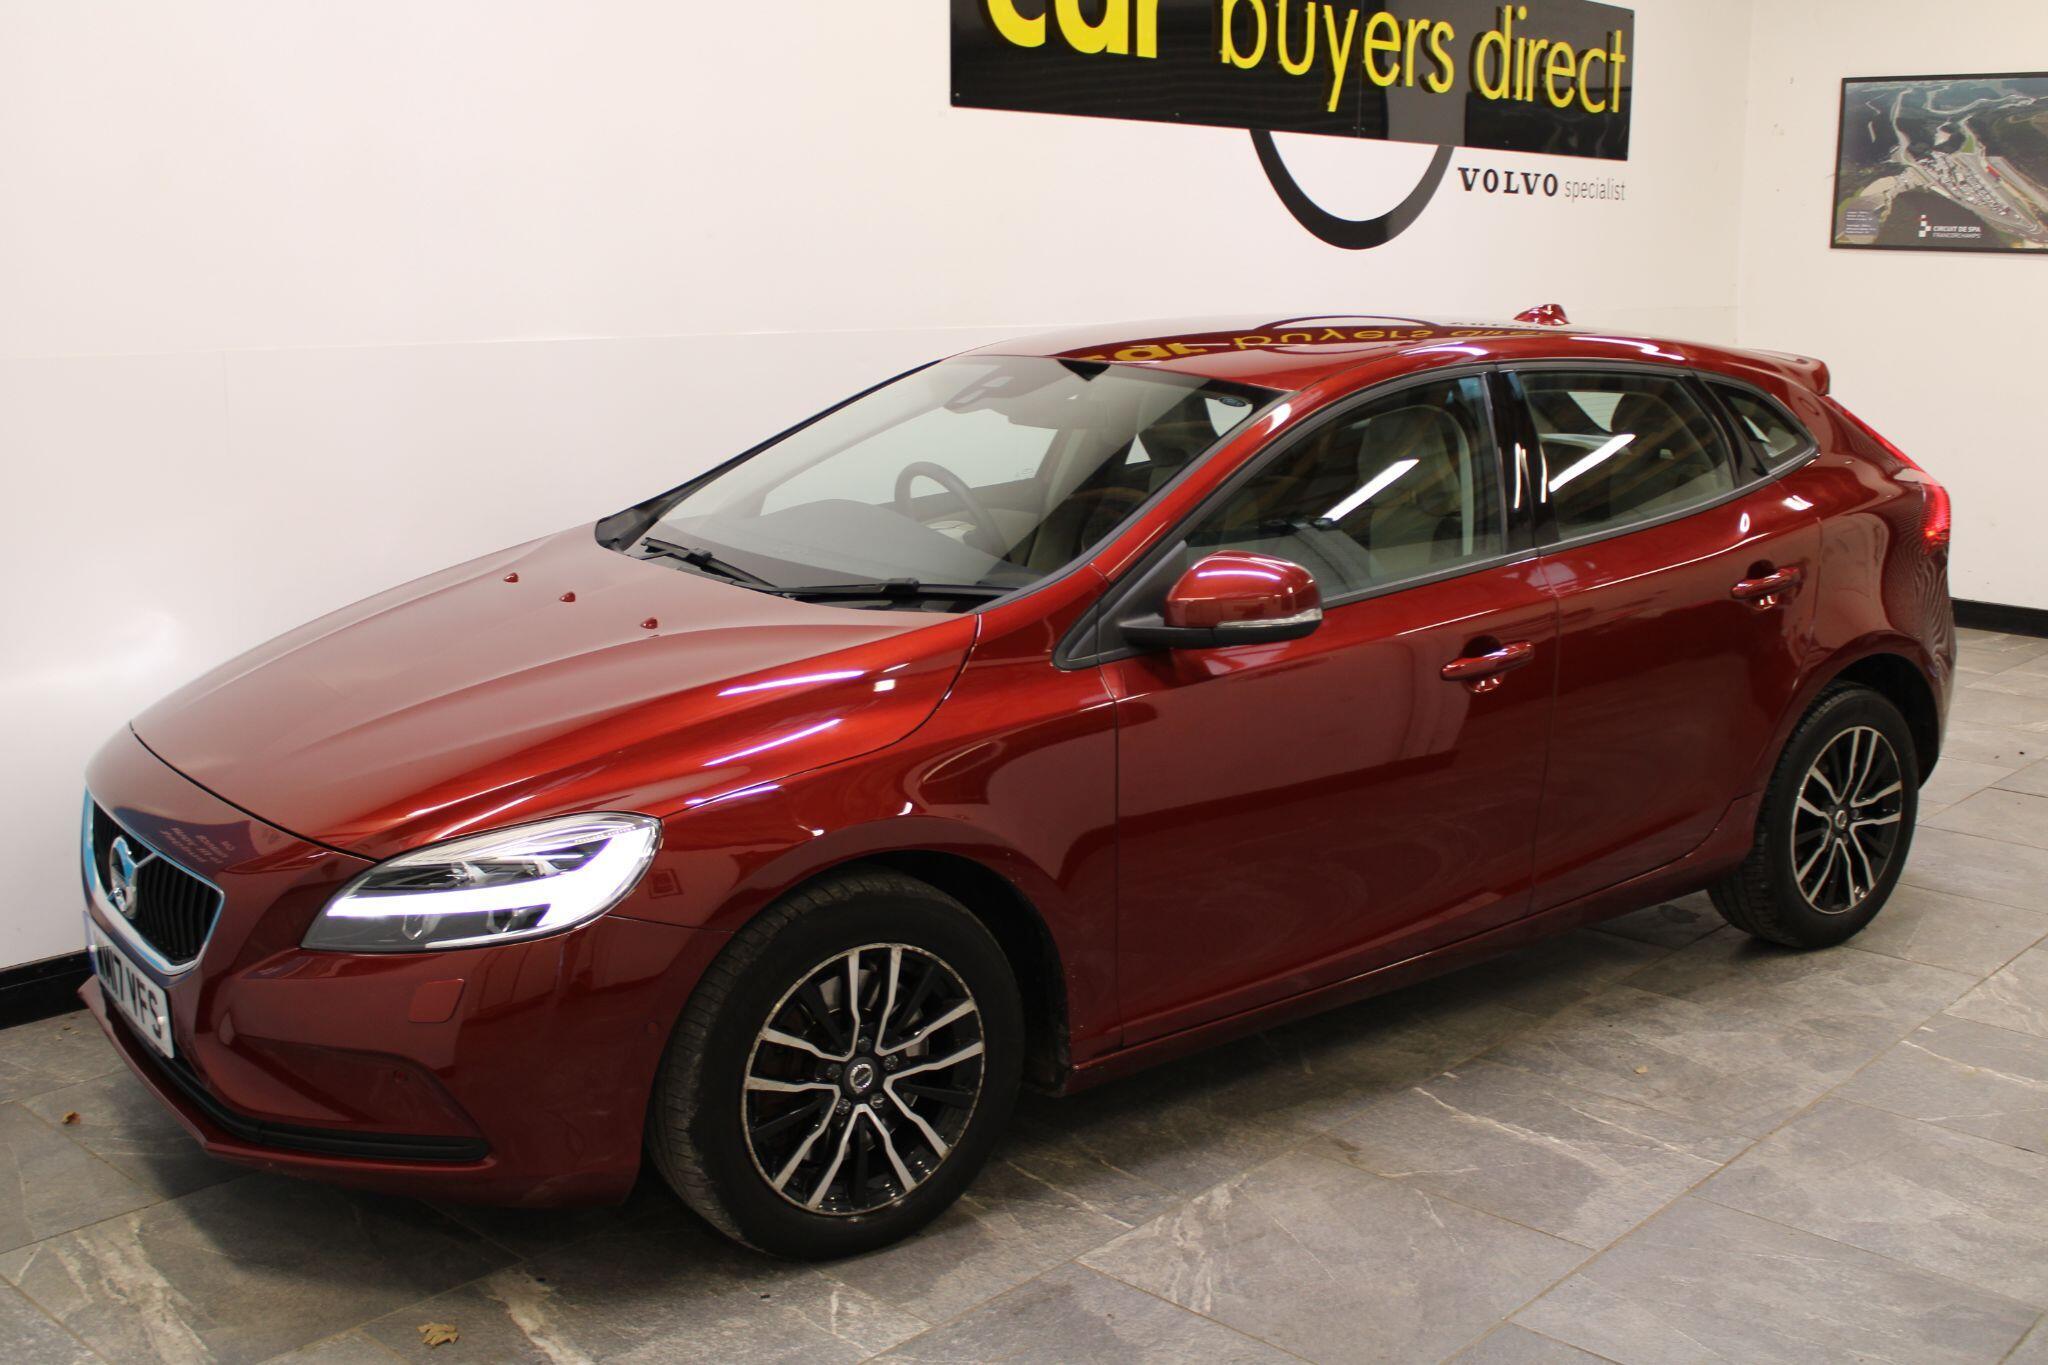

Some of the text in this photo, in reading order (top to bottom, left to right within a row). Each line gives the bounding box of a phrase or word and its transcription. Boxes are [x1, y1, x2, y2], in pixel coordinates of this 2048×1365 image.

[1221, 0, 1455, 113] buyers
[1475, 5, 1627, 114] direct
[1458, 167, 1626, 203] VOLVO specialist
